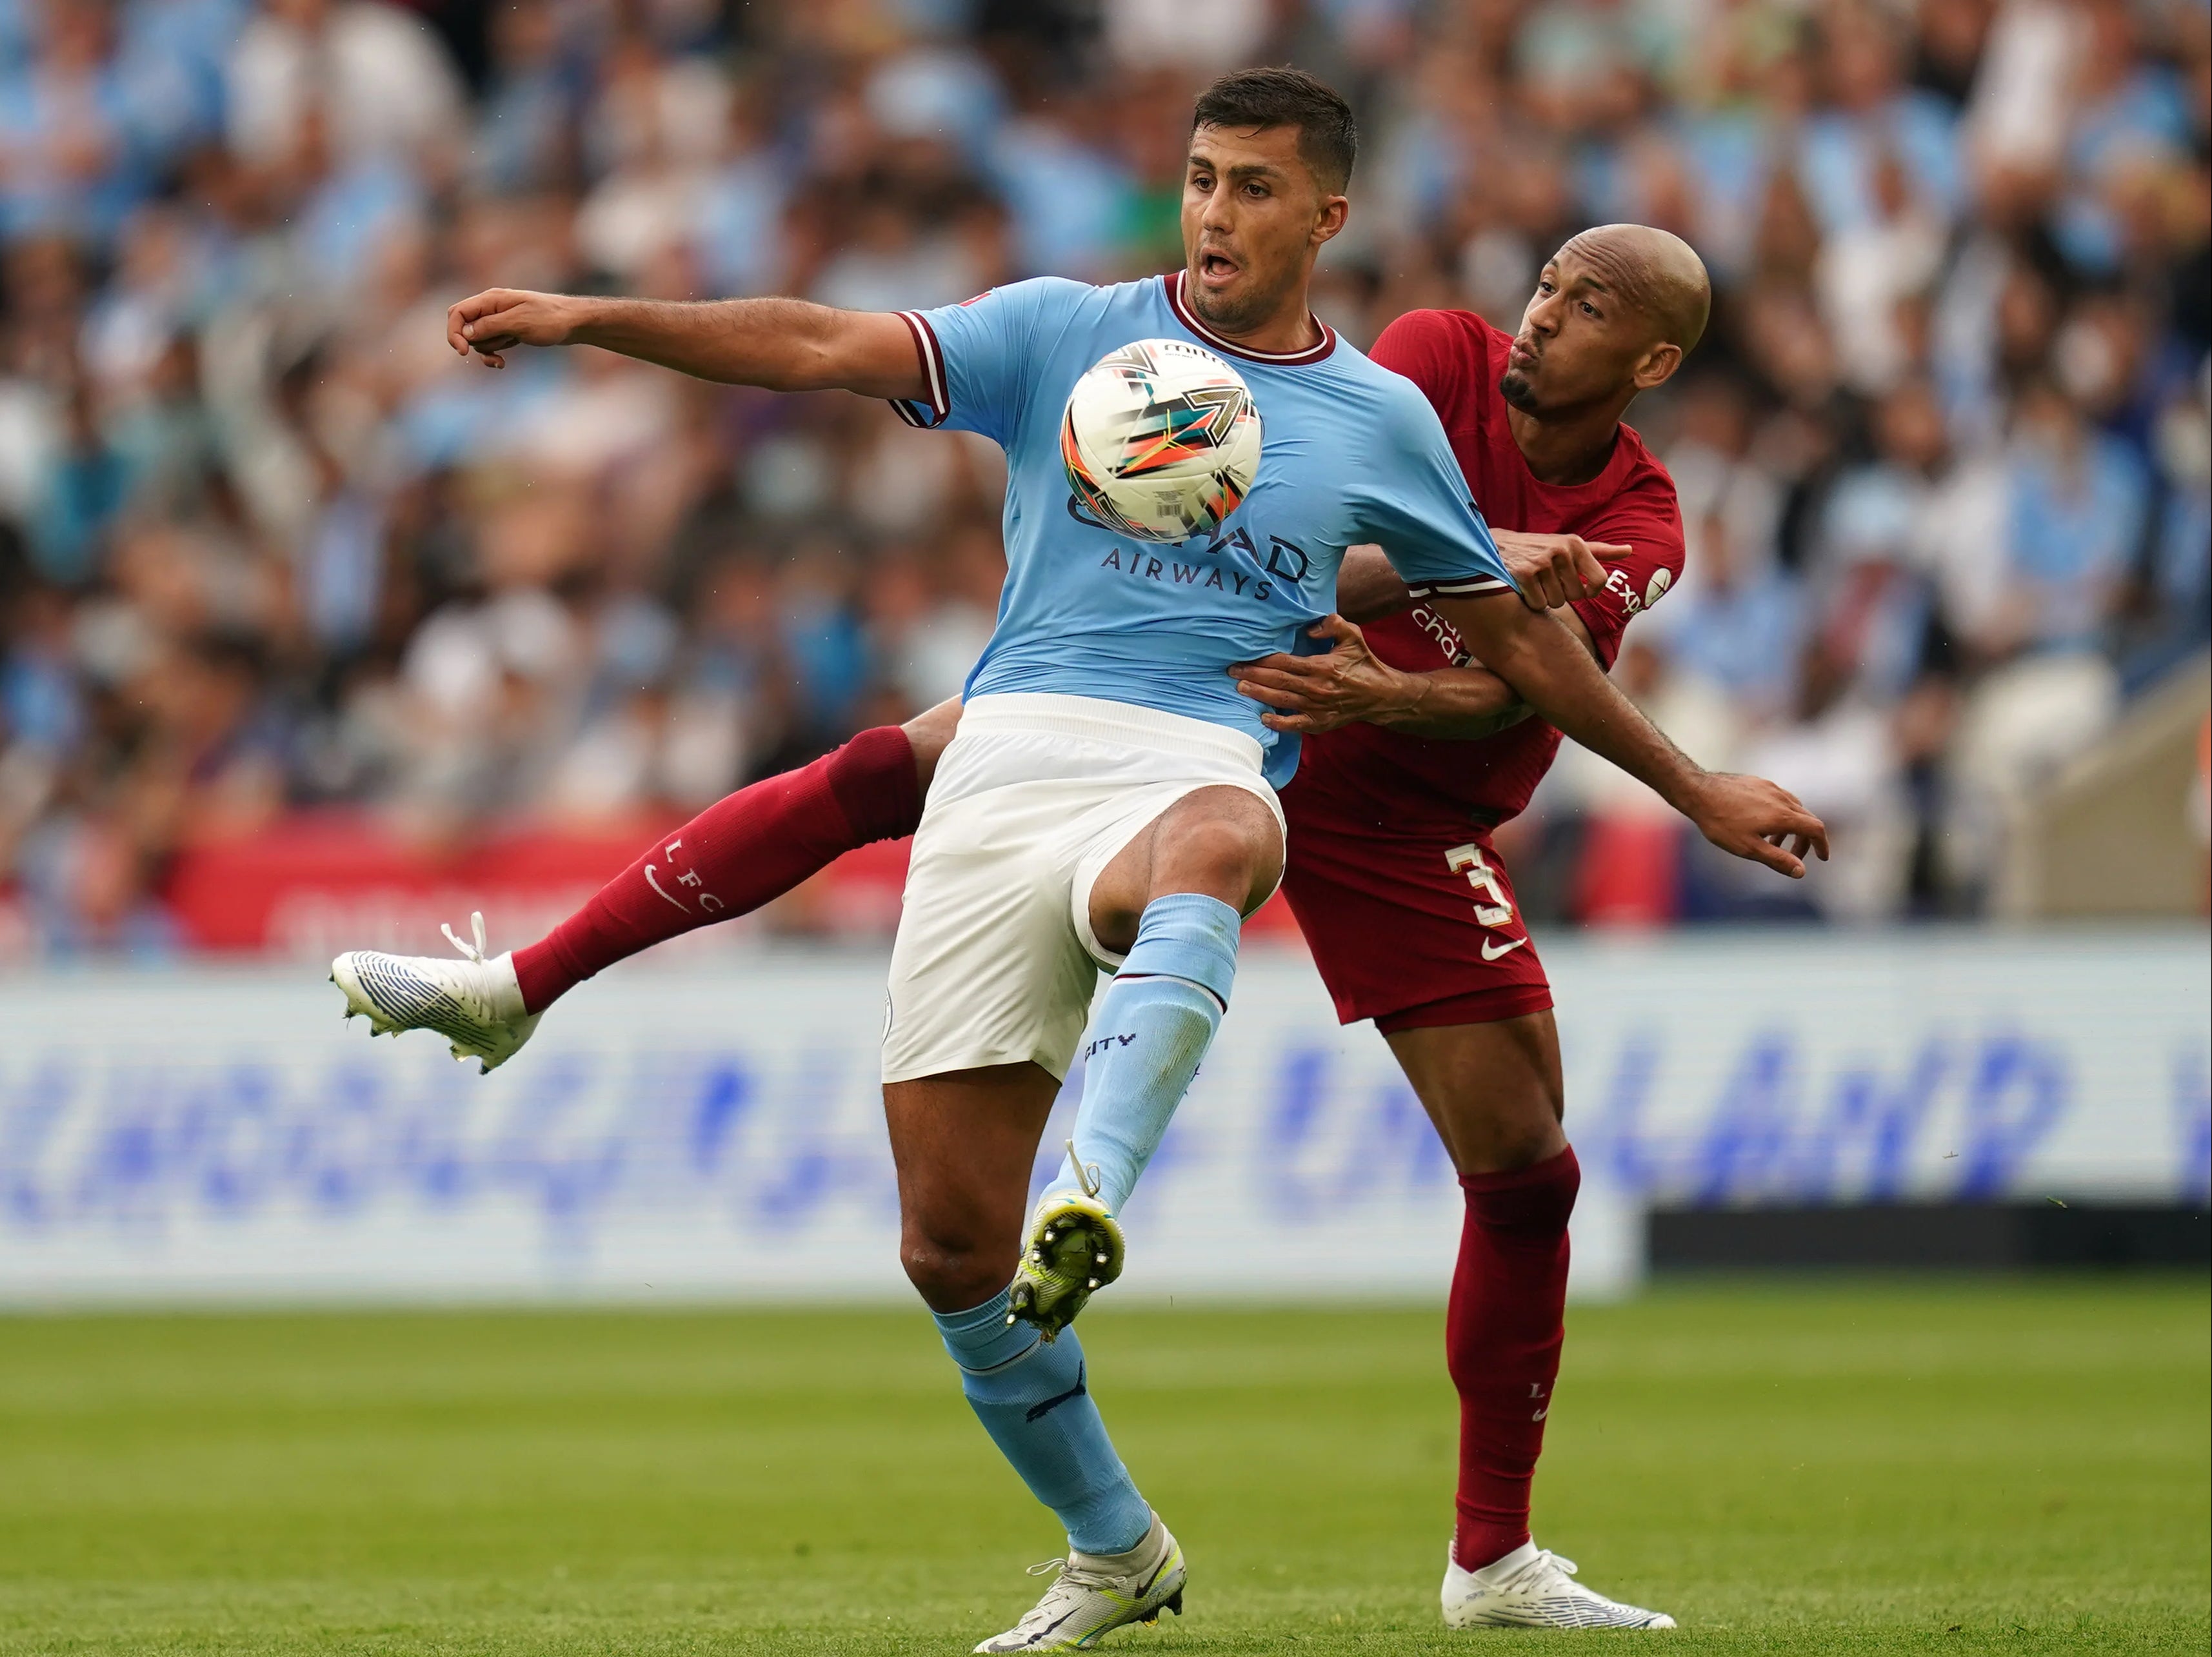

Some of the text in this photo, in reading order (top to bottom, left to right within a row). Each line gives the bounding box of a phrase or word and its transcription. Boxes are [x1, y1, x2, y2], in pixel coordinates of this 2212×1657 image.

[1101, 547, 1273, 601] AIRWAYS
[1605, 570, 1643, 614] Exp
[1444, 843, 1513, 928] 3
